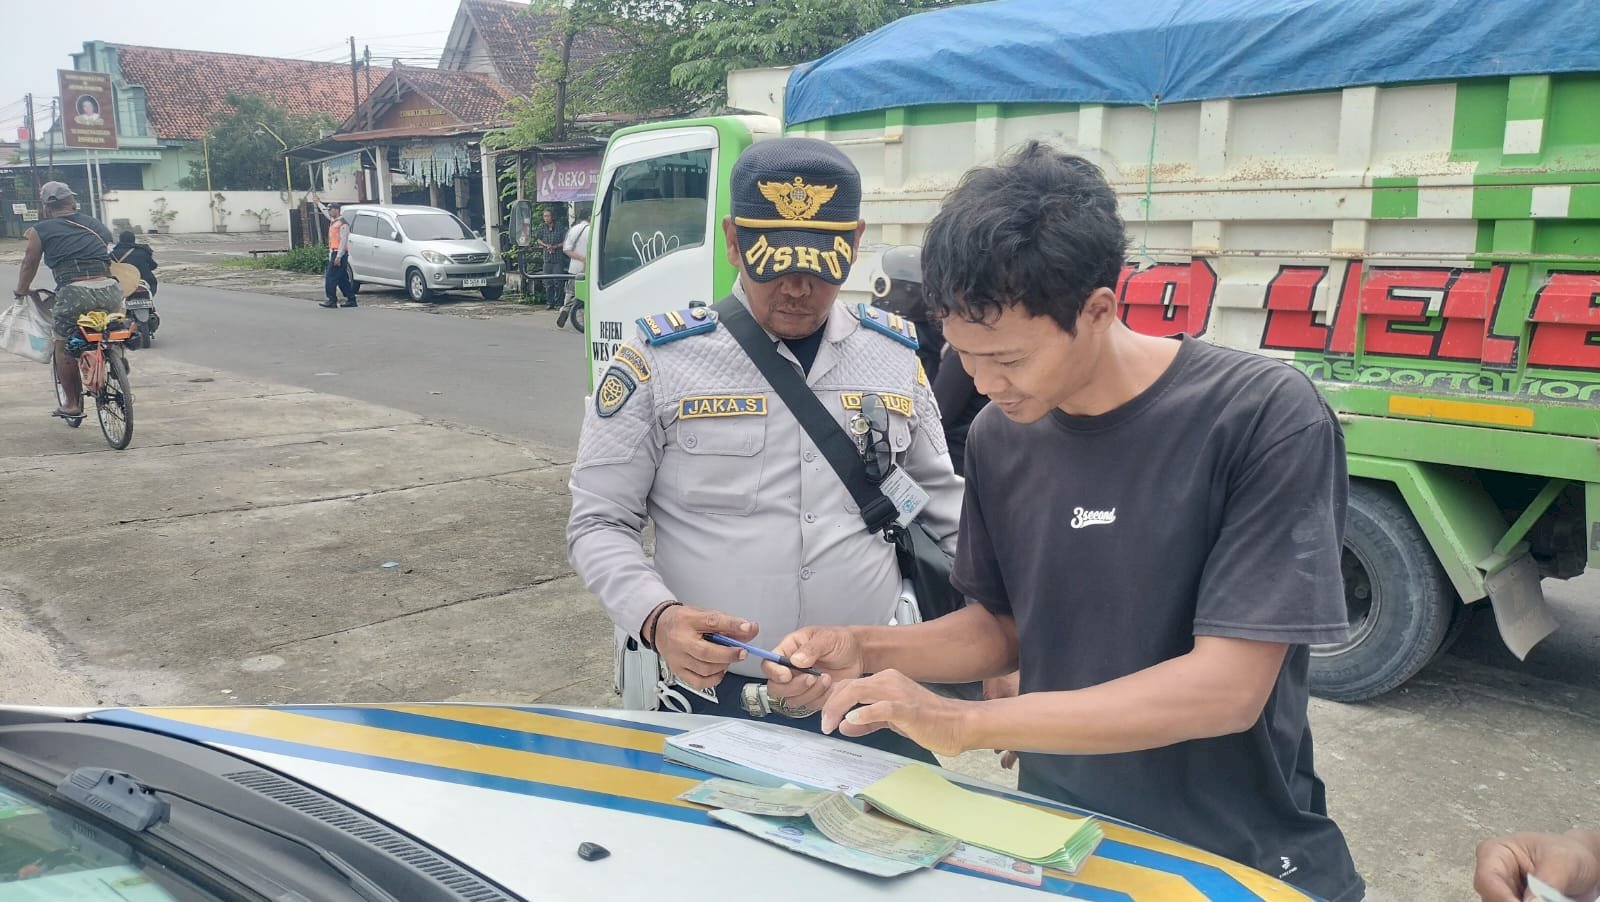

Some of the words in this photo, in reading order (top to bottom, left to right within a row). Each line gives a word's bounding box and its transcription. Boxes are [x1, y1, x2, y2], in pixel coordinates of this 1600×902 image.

[558, 171, 586, 187] REXO
[745, 234, 853, 279] DISHUB
[1113, 257, 1218, 339] O
[600, 321, 622, 341] REJEKI
[592, 342, 609, 361] WES
[688, 398, 757, 414] JAKA.S
[848, 395, 910, 412] DHUB
[1071, 507, 1116, 528] 3second
